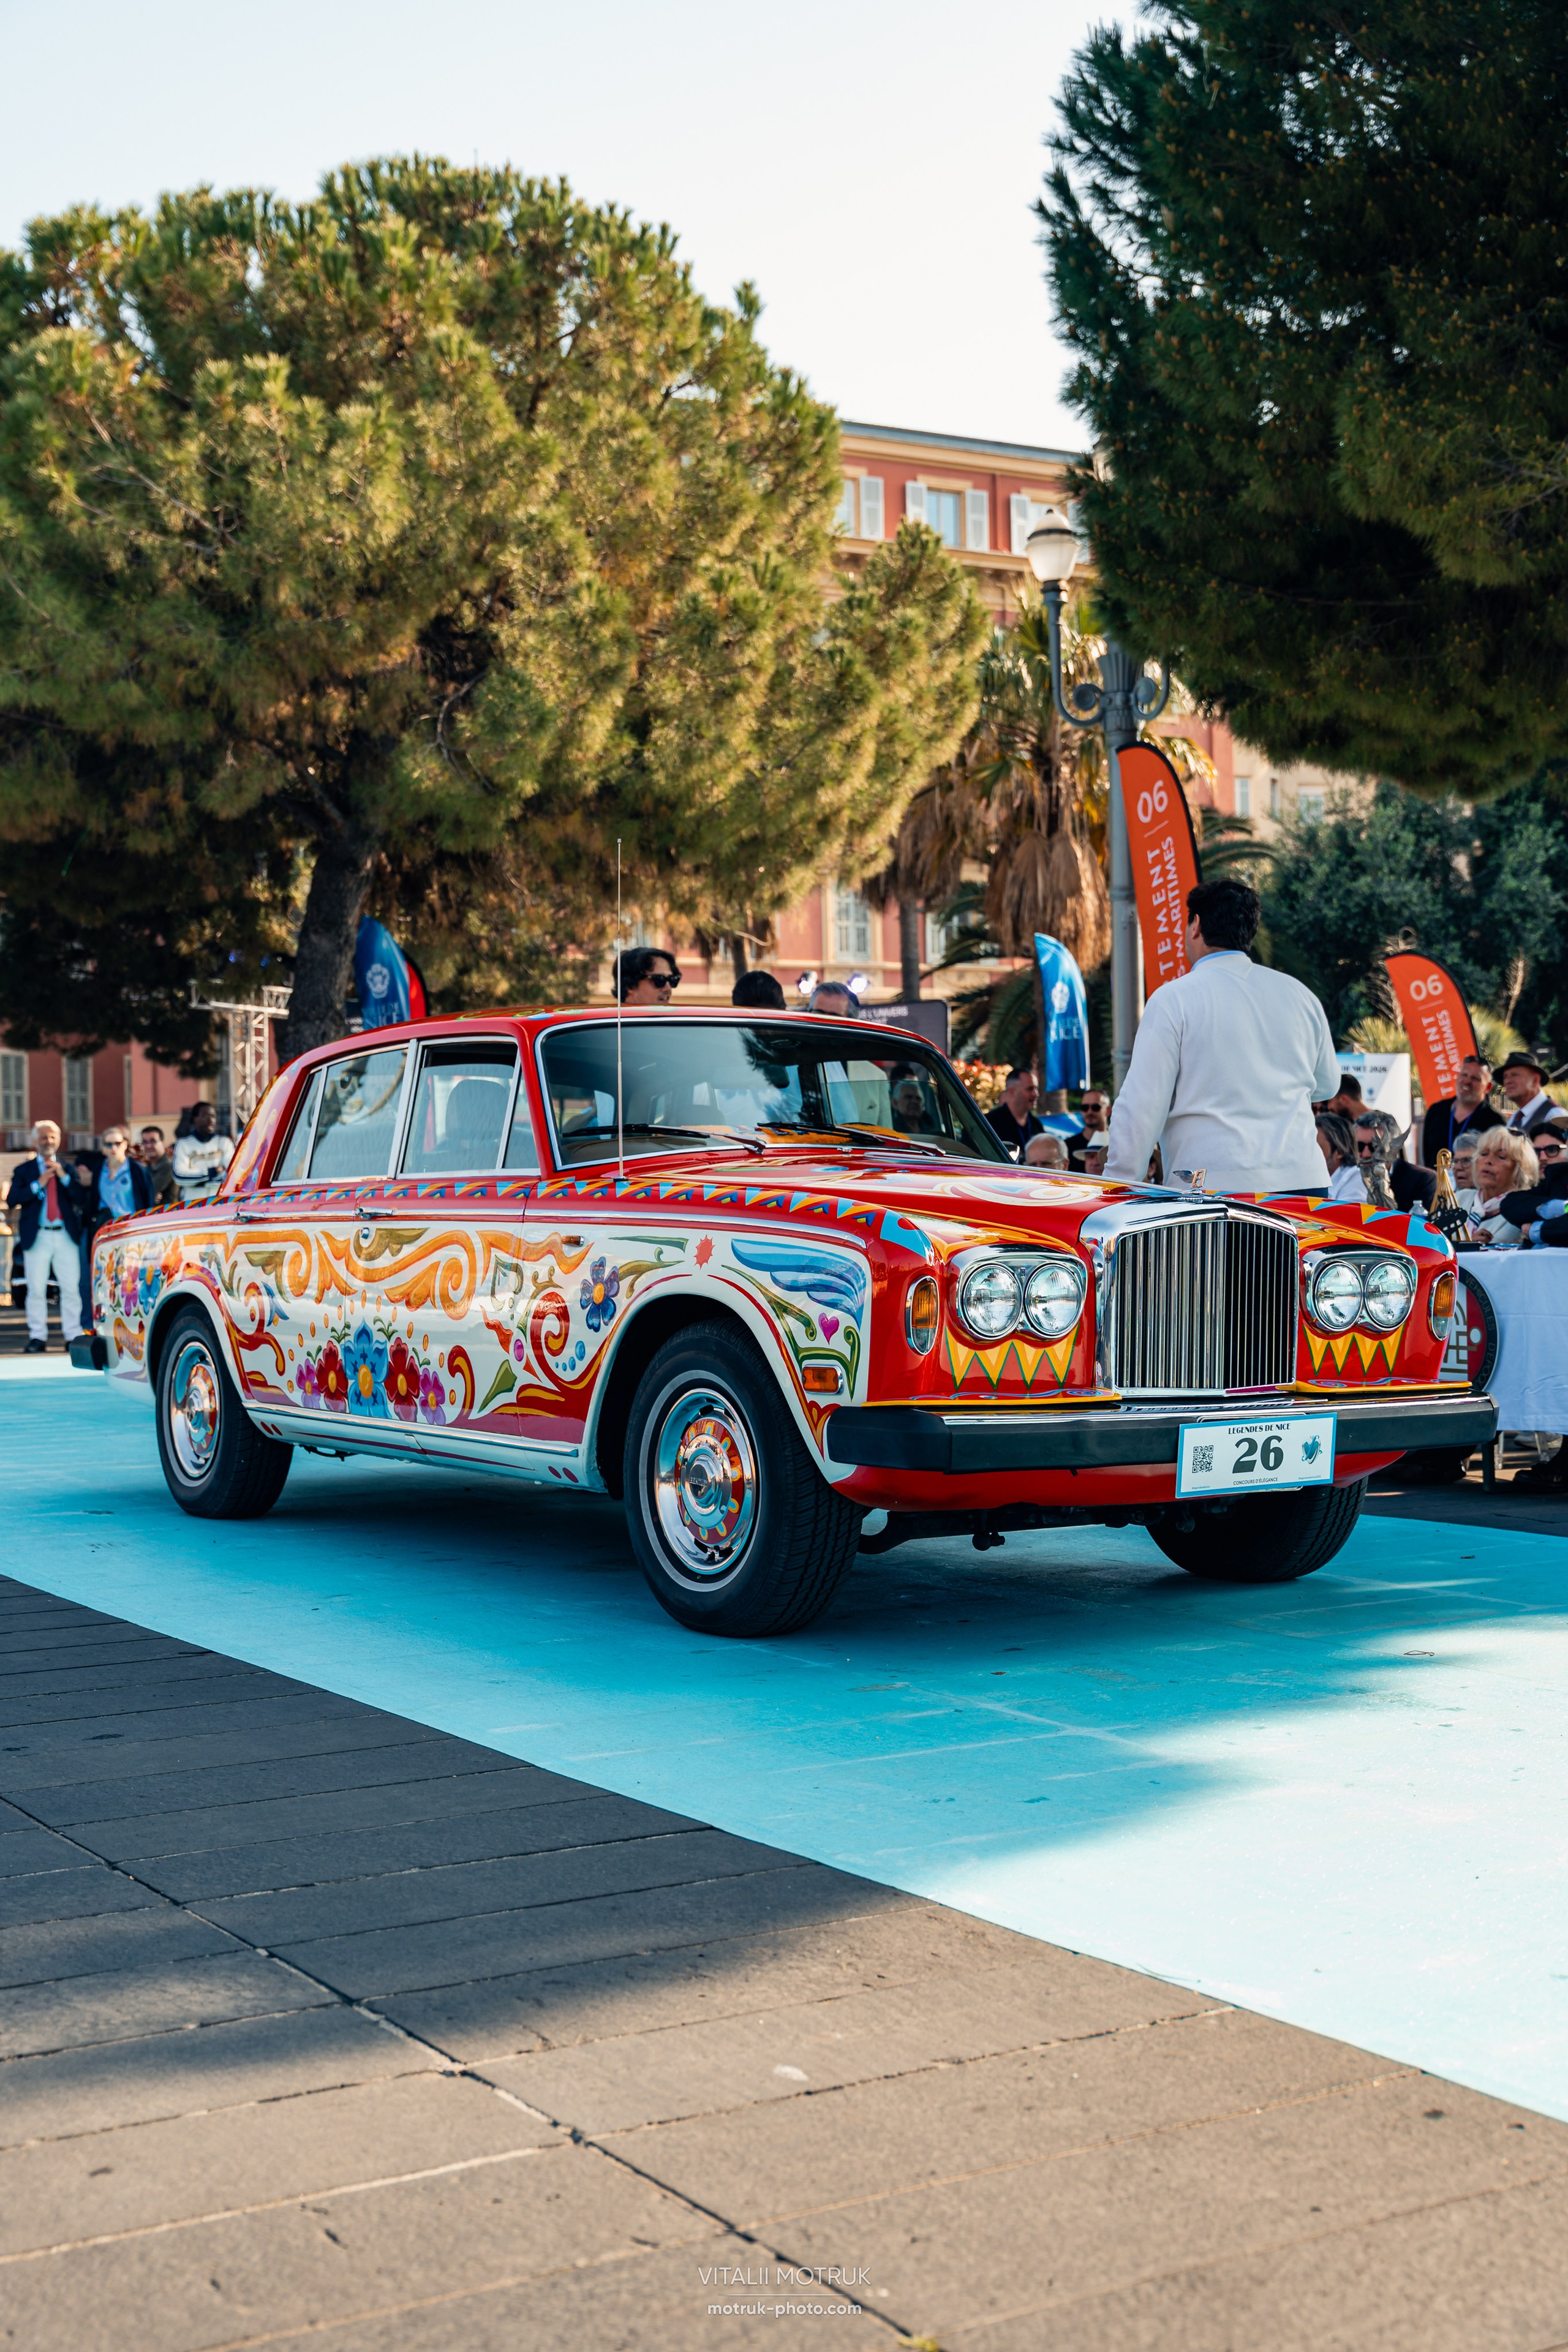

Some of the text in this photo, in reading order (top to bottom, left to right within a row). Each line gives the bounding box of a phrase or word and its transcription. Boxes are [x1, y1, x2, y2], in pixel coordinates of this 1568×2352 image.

[1137, 780, 1168, 823] 06
[1147, 848, 1176, 985] TEMENT
[1410, 974, 1443, 1001] 06
[1436, 1009, 1461, 1080] ARITIMES
[1228, 1425, 1264, 1434] LEGENDES
[1232, 1435, 1284, 1474] 26
